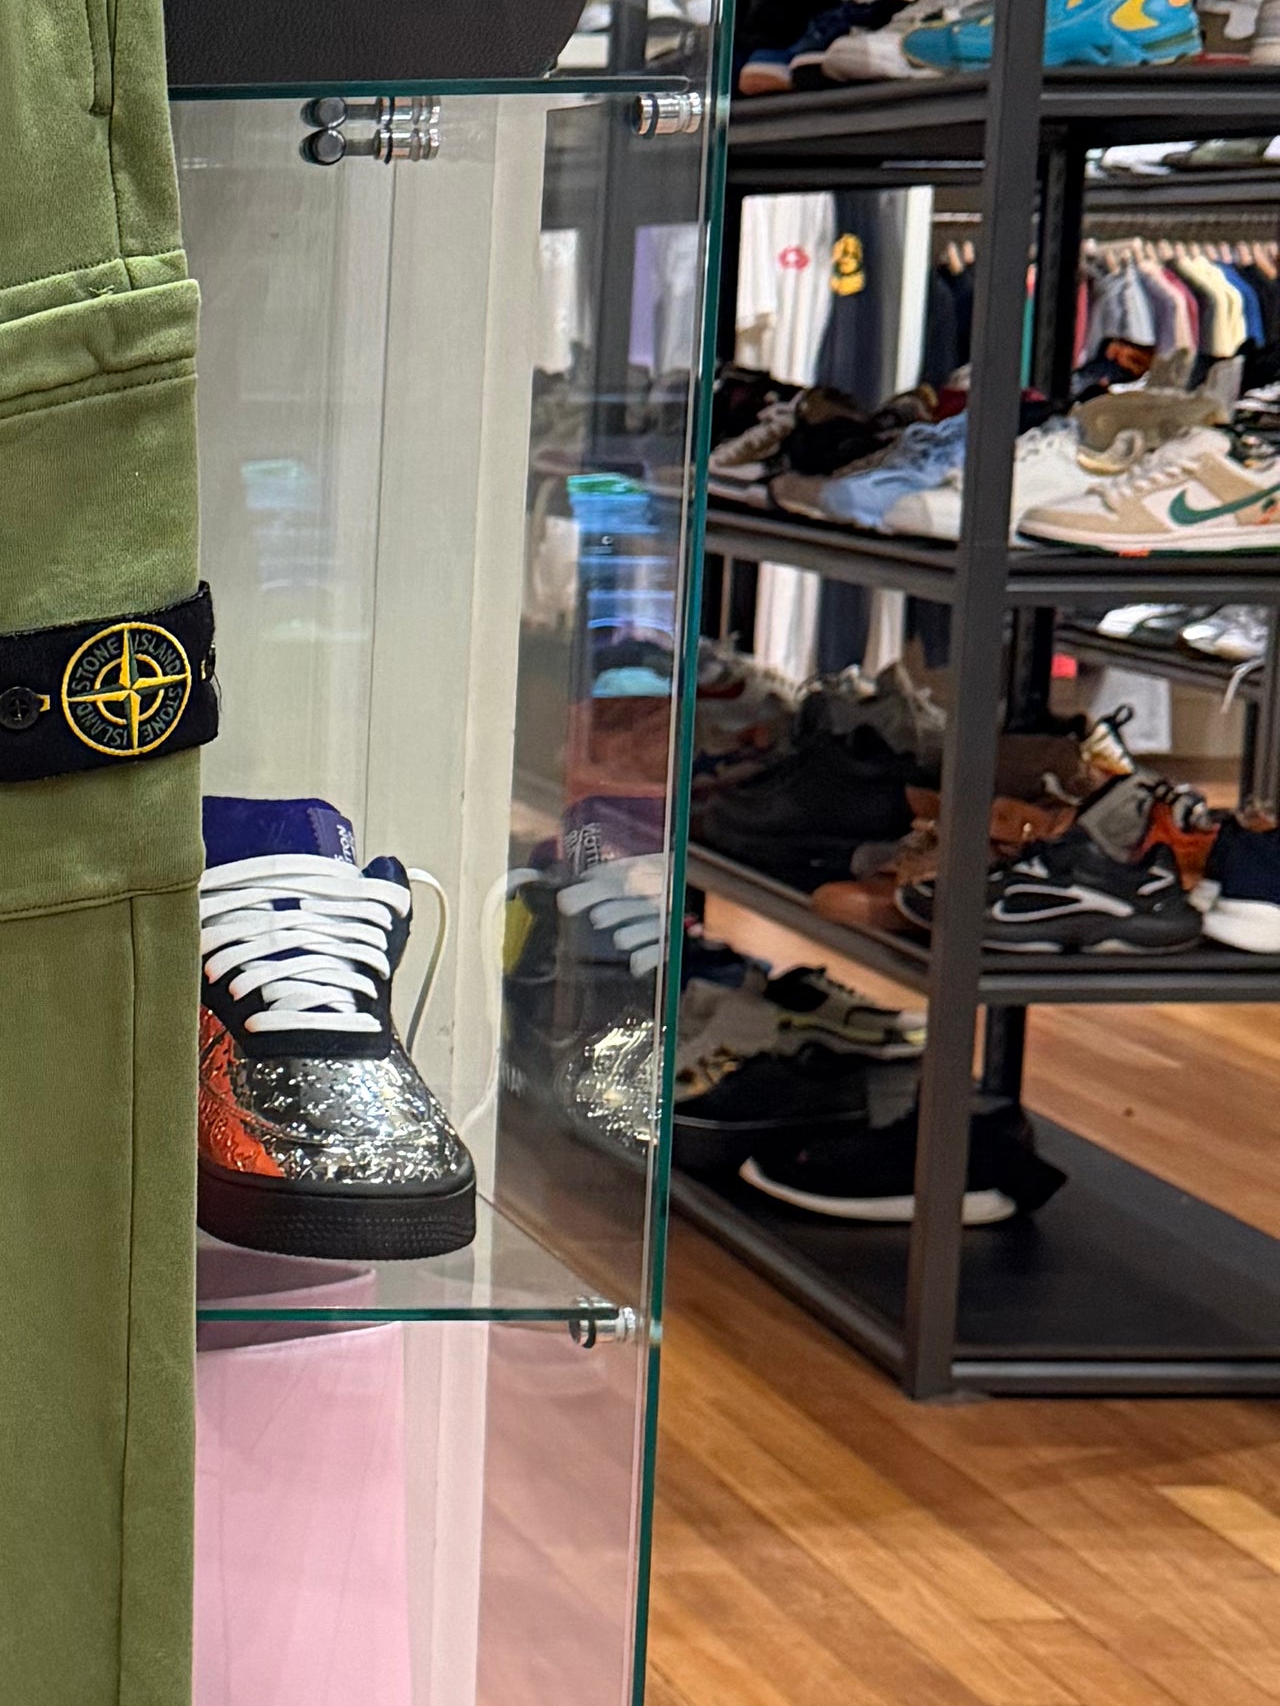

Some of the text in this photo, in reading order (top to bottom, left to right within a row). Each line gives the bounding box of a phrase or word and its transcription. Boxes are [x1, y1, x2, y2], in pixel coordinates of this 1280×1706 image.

[71, 632, 183, 692] STONE ISLAND
[76, 686, 183, 746] STONE ISLAND
